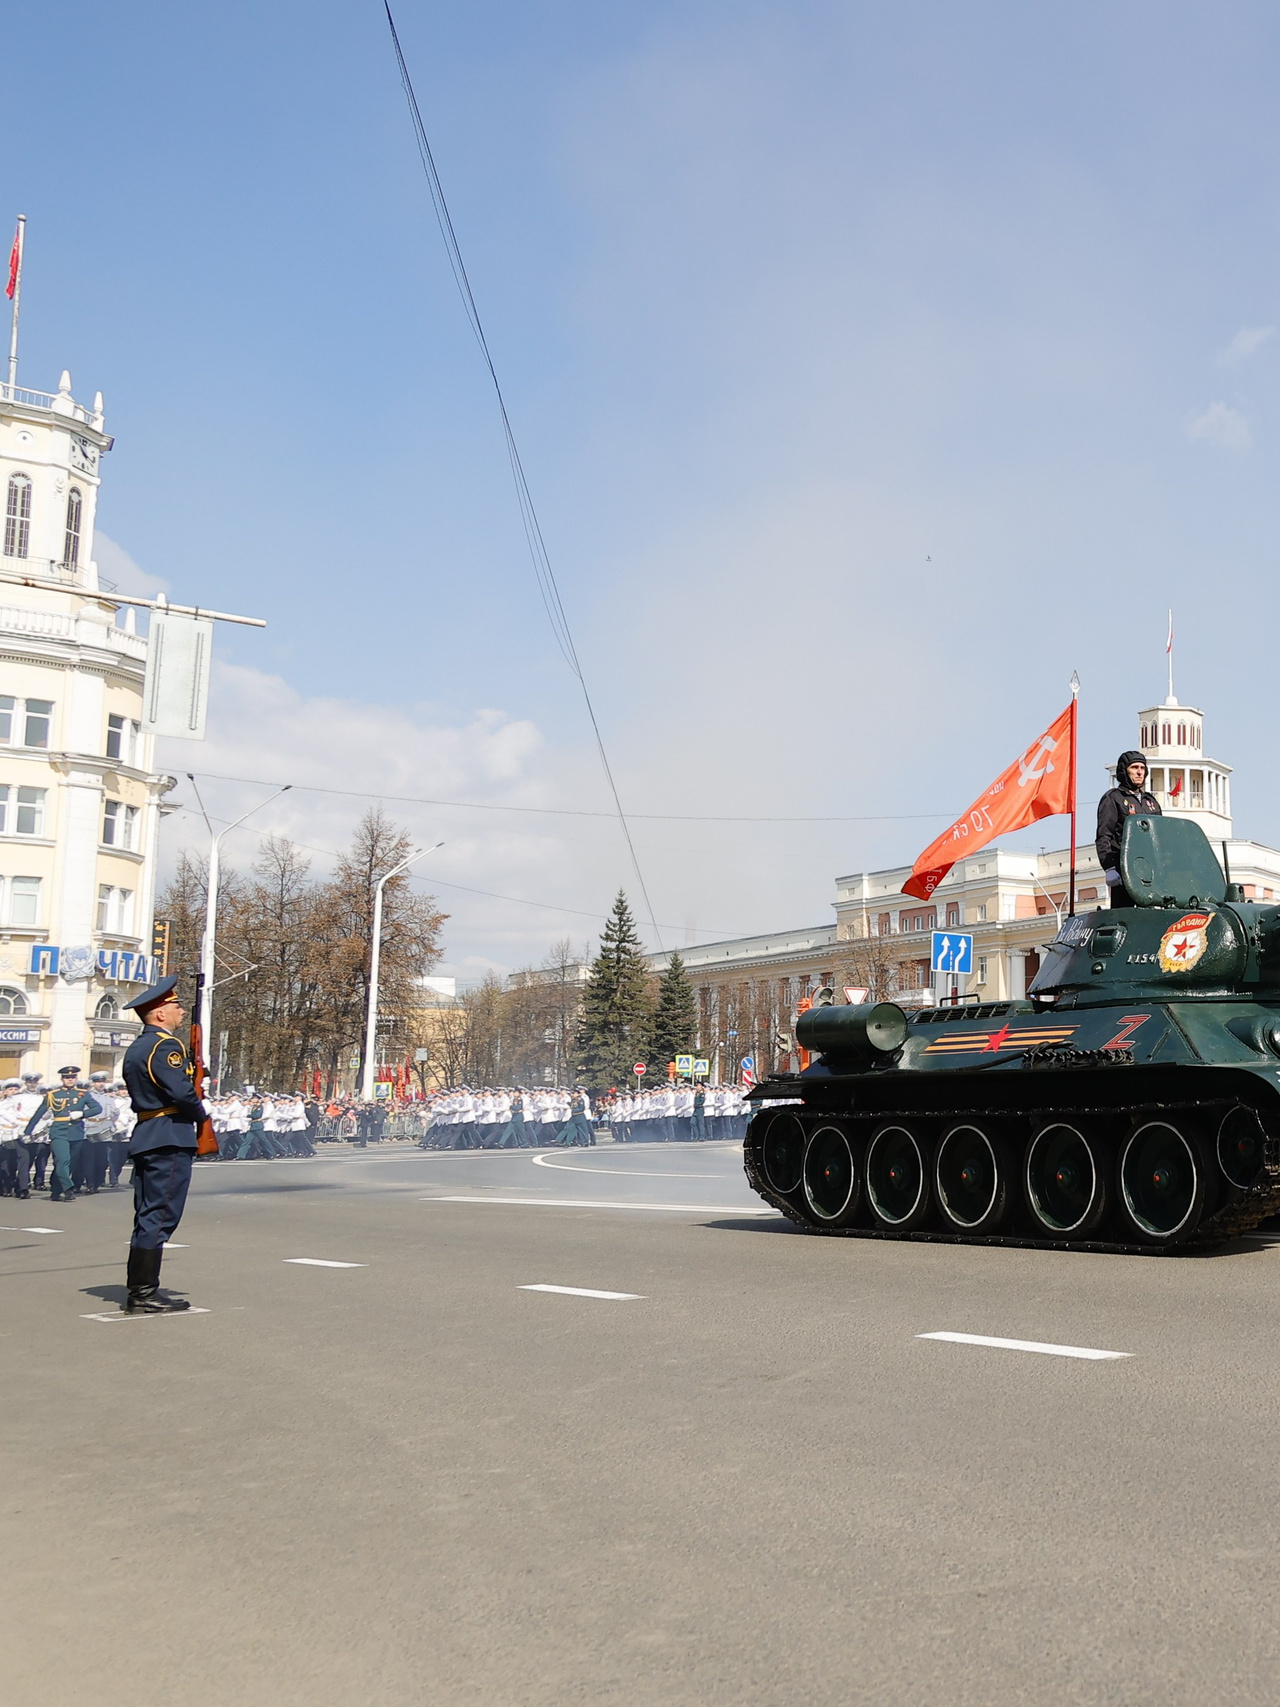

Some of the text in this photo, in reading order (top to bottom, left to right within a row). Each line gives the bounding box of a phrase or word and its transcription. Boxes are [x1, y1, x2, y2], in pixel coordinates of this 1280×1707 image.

[1064, 919, 1094, 946] Родину
[1172, 917, 1207, 931] ГВАРДИЯ
[0, 1031, 26, 1041] ССИИ
[1099, 1013, 1152, 1051] Z
